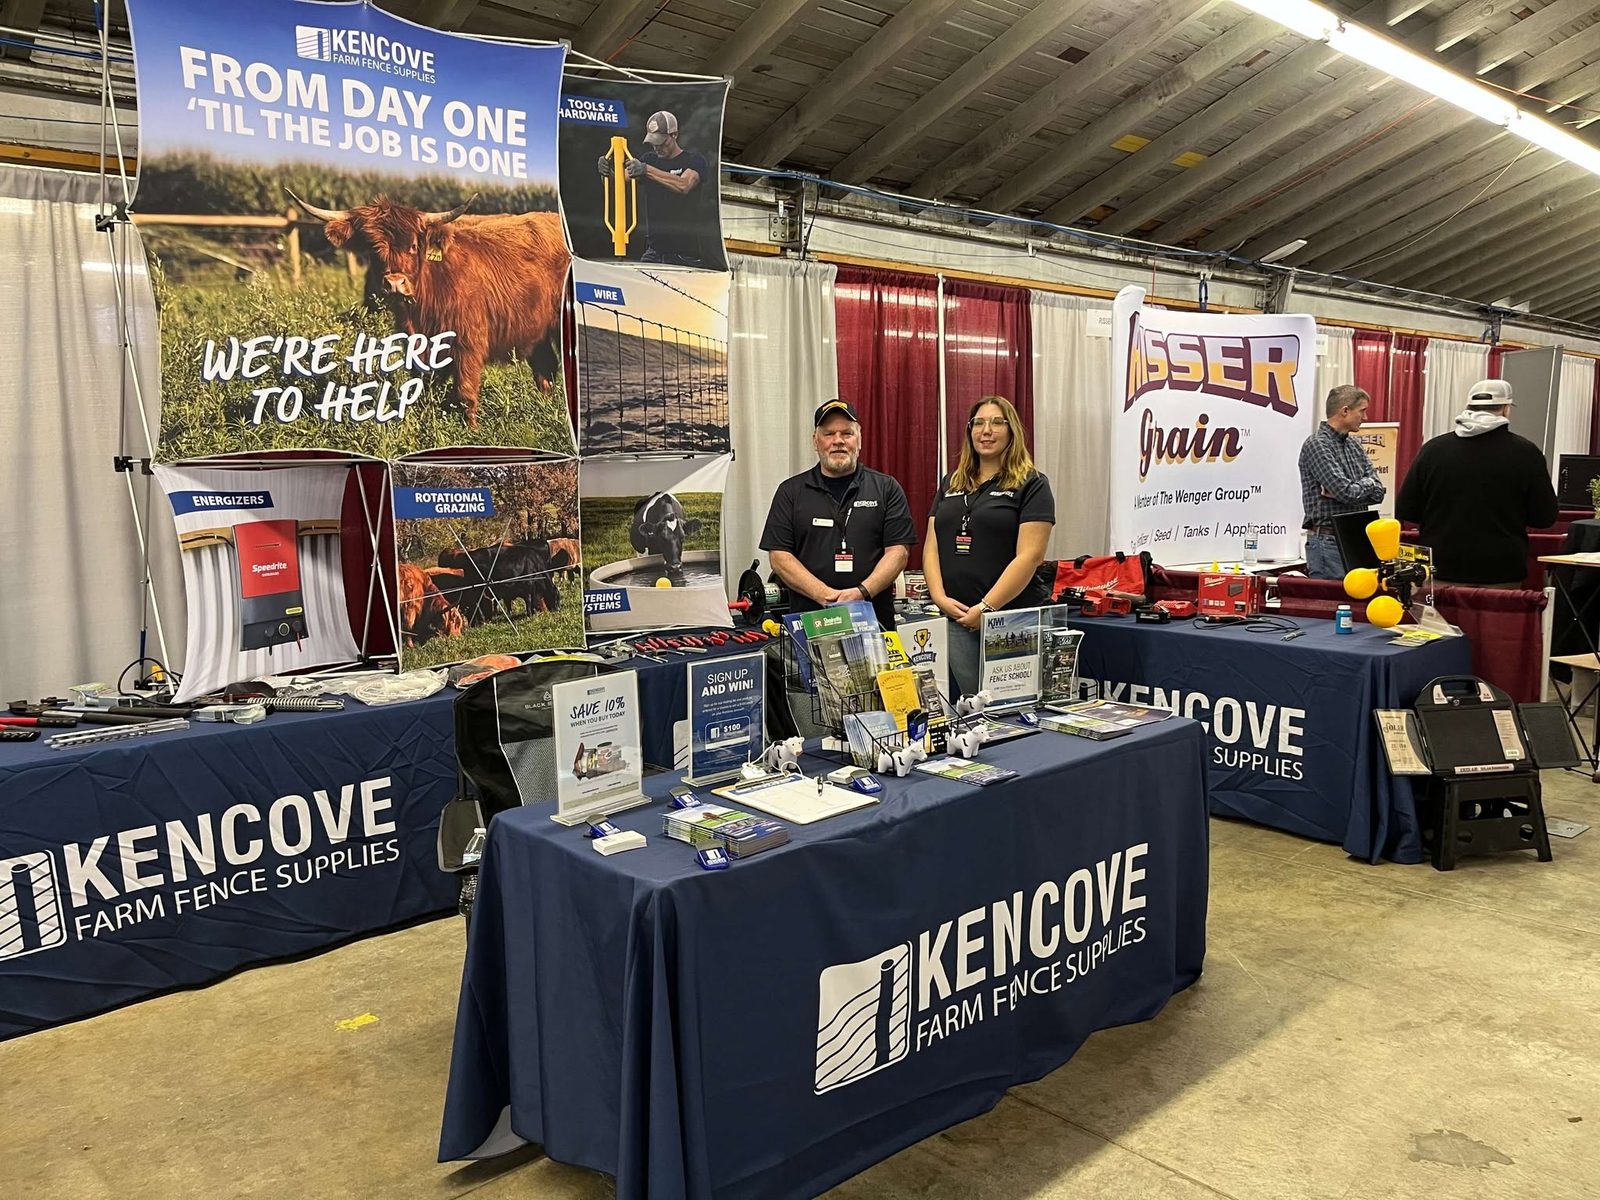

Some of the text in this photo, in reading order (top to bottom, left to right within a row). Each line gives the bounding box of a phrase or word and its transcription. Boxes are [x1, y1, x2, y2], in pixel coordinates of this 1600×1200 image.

[332, 29, 434, 73] KENCOVE
[333, 54, 436, 84] FARM FENCE SUPPLIES
[180, 46, 527, 147] FROM DAY ONE
[567, 98, 614, 112] TOOLS &
[260, 109, 331, 147] THE
[338, 122, 402, 157] JOB
[410, 134, 439, 164] IS
[446, 141, 528, 179] DONE
[593, 288, 618, 301] WIRE
[202, 331, 457, 381] WE'RE HERE
[252, 378, 424, 425] TO HELP
[192, 494, 265, 507] ENERGIZERS
[415, 492, 485, 503] ROTATIONAL
[1160, 490, 1173, 505] The
[1175, 489, 1212, 505] Wenger
[435, 503, 486, 513] GRAZING
[1154, 528, 1173, 542] Seed
[1183, 525, 1210, 538] Tanks
[252, 562, 288, 573] Speedrite
[584, 592, 621, 603] TERING
[987, 616, 1005, 629] KIWI
[707, 668, 748, 684] SIGN UP
[989, 670, 1032, 683] FENCE SCHOOL!
[992, 662, 1031, 675] ASK US ABOUT
[701, 679, 754, 697] AND WIN!
[570, 696, 626, 720] SAVE 10%
[570, 711, 626, 728] WHEN YOU BUY TODAY
[1103, 680, 1306, 756] KENCOVE
[723, 723, 741, 733] $100
[1213, 746, 1303, 780] SUPPLIES
[63, 776, 397, 908] KENCOVE
[74, 839, 400, 941] FARM FENCE SUPPLIES
[918, 843, 1148, 1012] KENCOVE
[916, 916, 1147, 1051] FARM FENCE SUPPLIES
